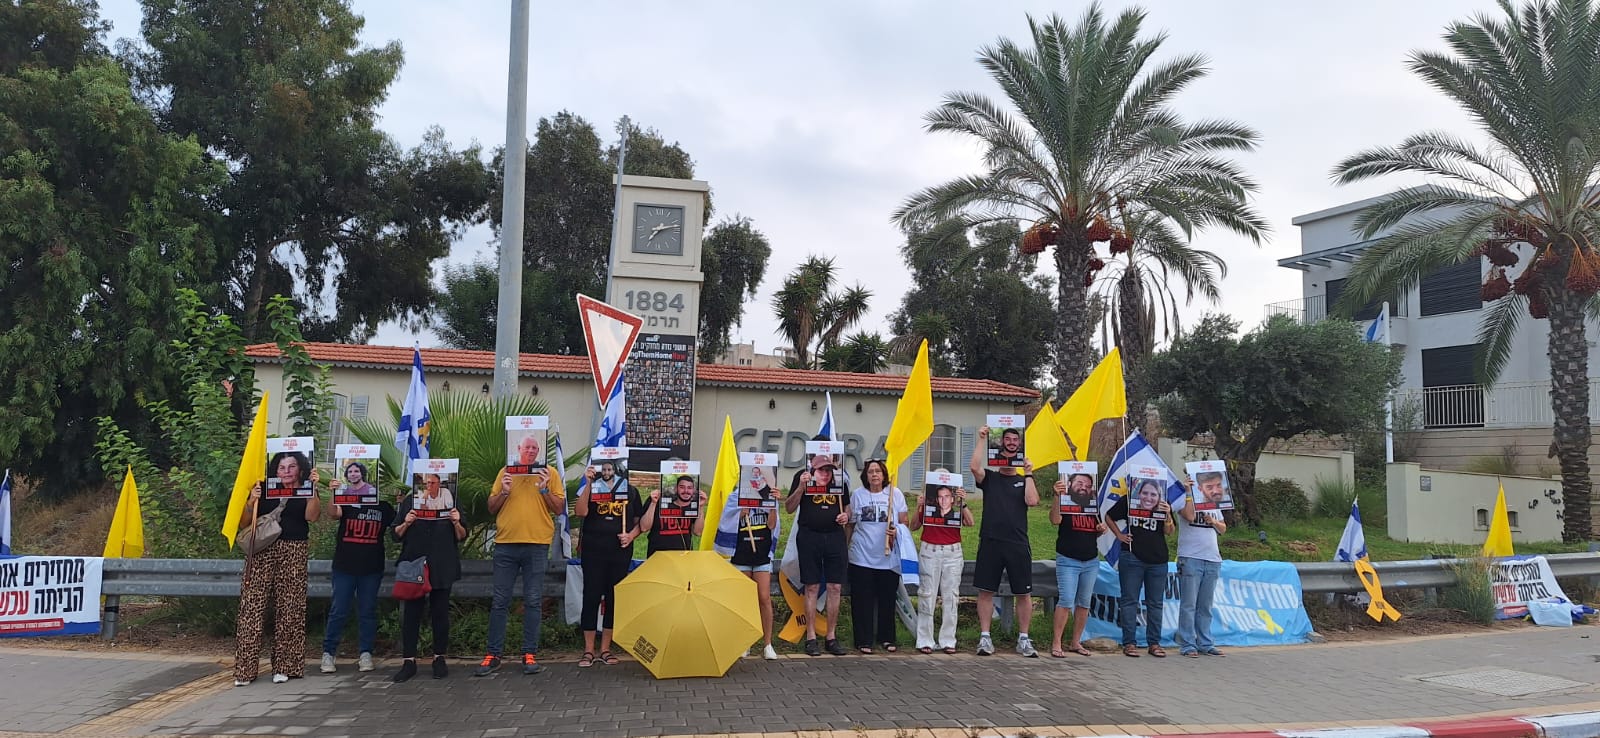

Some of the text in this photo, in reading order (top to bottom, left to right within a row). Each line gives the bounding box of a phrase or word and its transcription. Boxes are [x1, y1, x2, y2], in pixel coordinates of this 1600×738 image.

[625, 290, 685, 312] 1884
[641, 315, 679, 328] תרמ"
[734, 428, 888, 470] GEDRA
[345, 518, 381, 538] עכשיו
[1072, 515, 1096, 529] NOW
[24, 558, 85, 586] מחזירים
[1511, 562, 1541, 581] מחזירים
[34, 587, 84, 614] הביתה
[1229, 578, 1298, 609] מחזירים
[1492, 582, 1552, 604] הביתה עכשיו
[796, 614, 807, 626] NO
